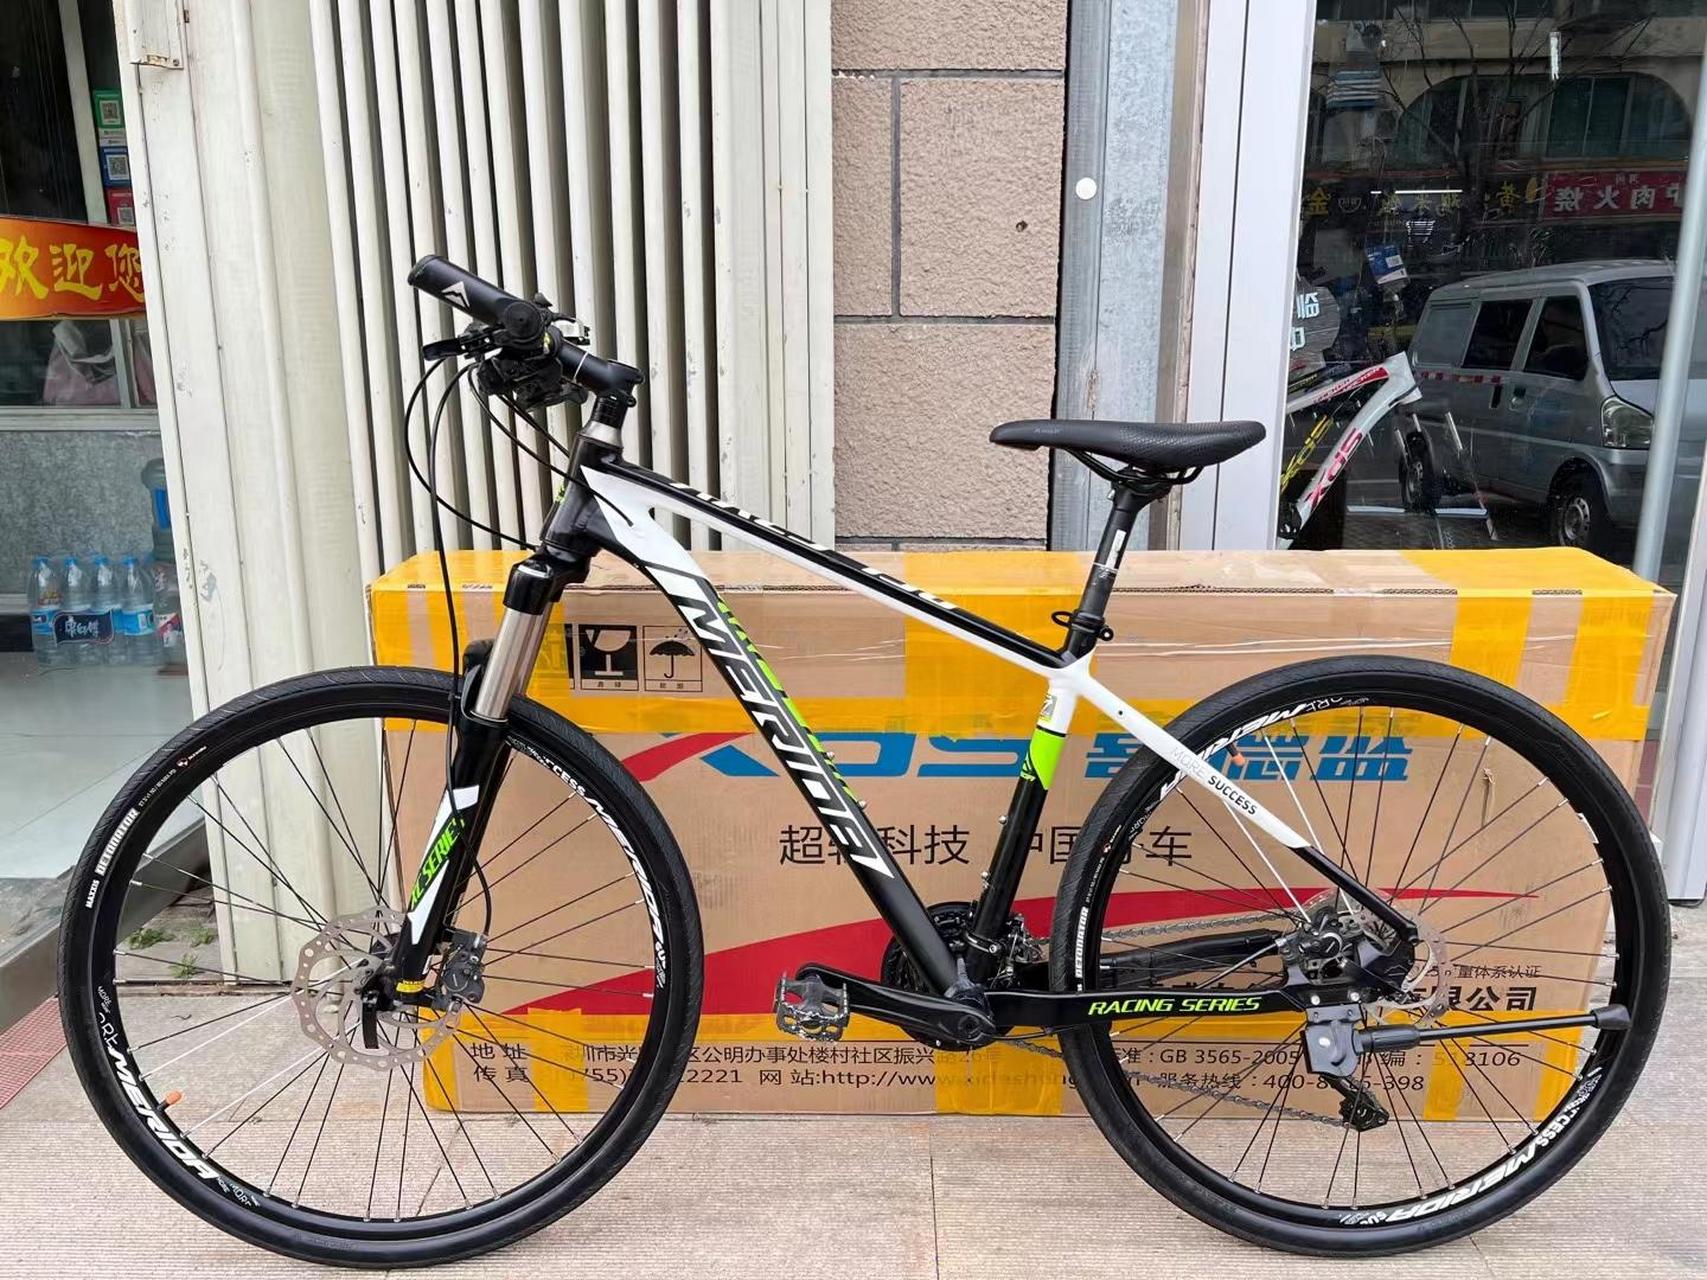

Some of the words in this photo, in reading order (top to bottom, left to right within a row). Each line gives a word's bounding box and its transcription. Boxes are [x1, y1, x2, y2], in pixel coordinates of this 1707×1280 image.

[0, 235, 145, 304] 欢迎您
[1160, 702, 1305, 801] MERIA
[1207, 774, 1258, 816] SUCCESS
[94, 807, 140, 877] DETONATOR
[1028, 825, 1193, 867] 国车
[586, 797, 665, 945] MERIDA
[85, 879, 100, 909] MAXXIS
[1074, 906, 1090, 978] DETONATOR
[1452, 964, 1544, 981] 量体系认证
[1088, 998, 1175, 1019] RACING
[1178, 996, 1263, 1014] SERIES
[473, 1065, 530, 1083] 传真
[1159, 1050, 1188, 1064] GB
[1194, 1050, 1300, 1065] 3565-2005
[1262, 1075, 1425, 1092] 400-85-398
[108, 1048, 219, 1180] MERIDA
[1385, 1146, 1537, 1222] MERIDA
